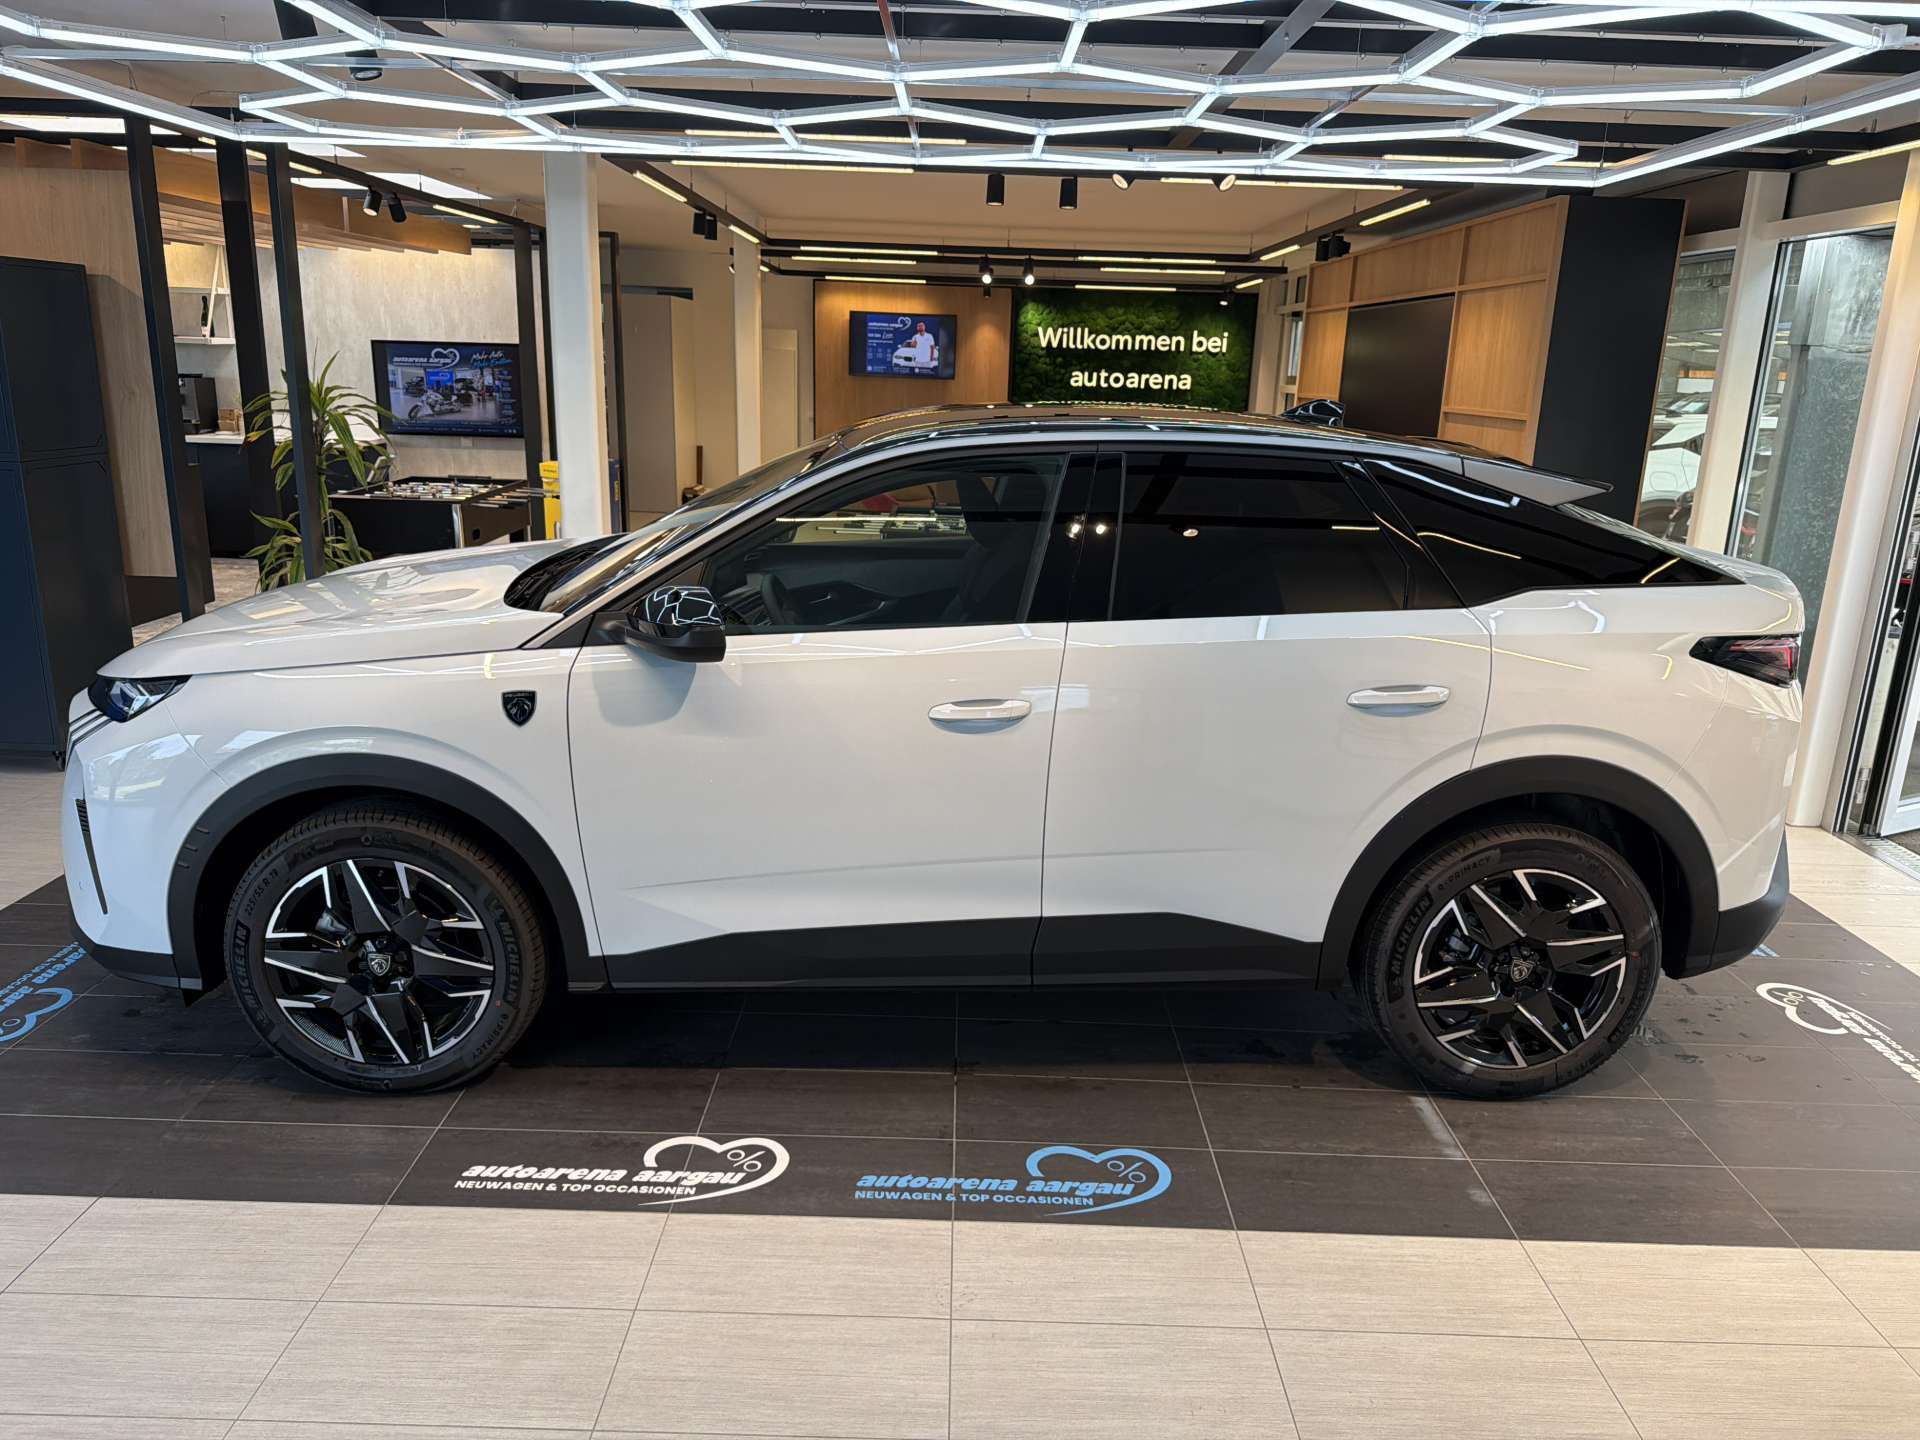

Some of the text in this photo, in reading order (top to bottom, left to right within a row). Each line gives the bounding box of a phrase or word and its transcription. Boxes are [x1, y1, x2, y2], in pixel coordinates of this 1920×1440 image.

[1037, 327, 1229, 353] Willkommen bei
[1070, 369, 1192, 390] autoarena
[1391, 895, 1431, 976] MICHELIN
[233, 921, 260, 1009] MICHELIN
[499, 919, 521, 1003] MICHELIN
[461, 1164, 747, 1186] autoarena aargau
[855, 1173, 1135, 1196] autoarena aargau
[454, 1180, 696, 1195] NEUWAGEN & TOP OCCASIONEN
[854, 1190, 1094, 1206] NEUWAGEN & TOP OCCASIONEN
